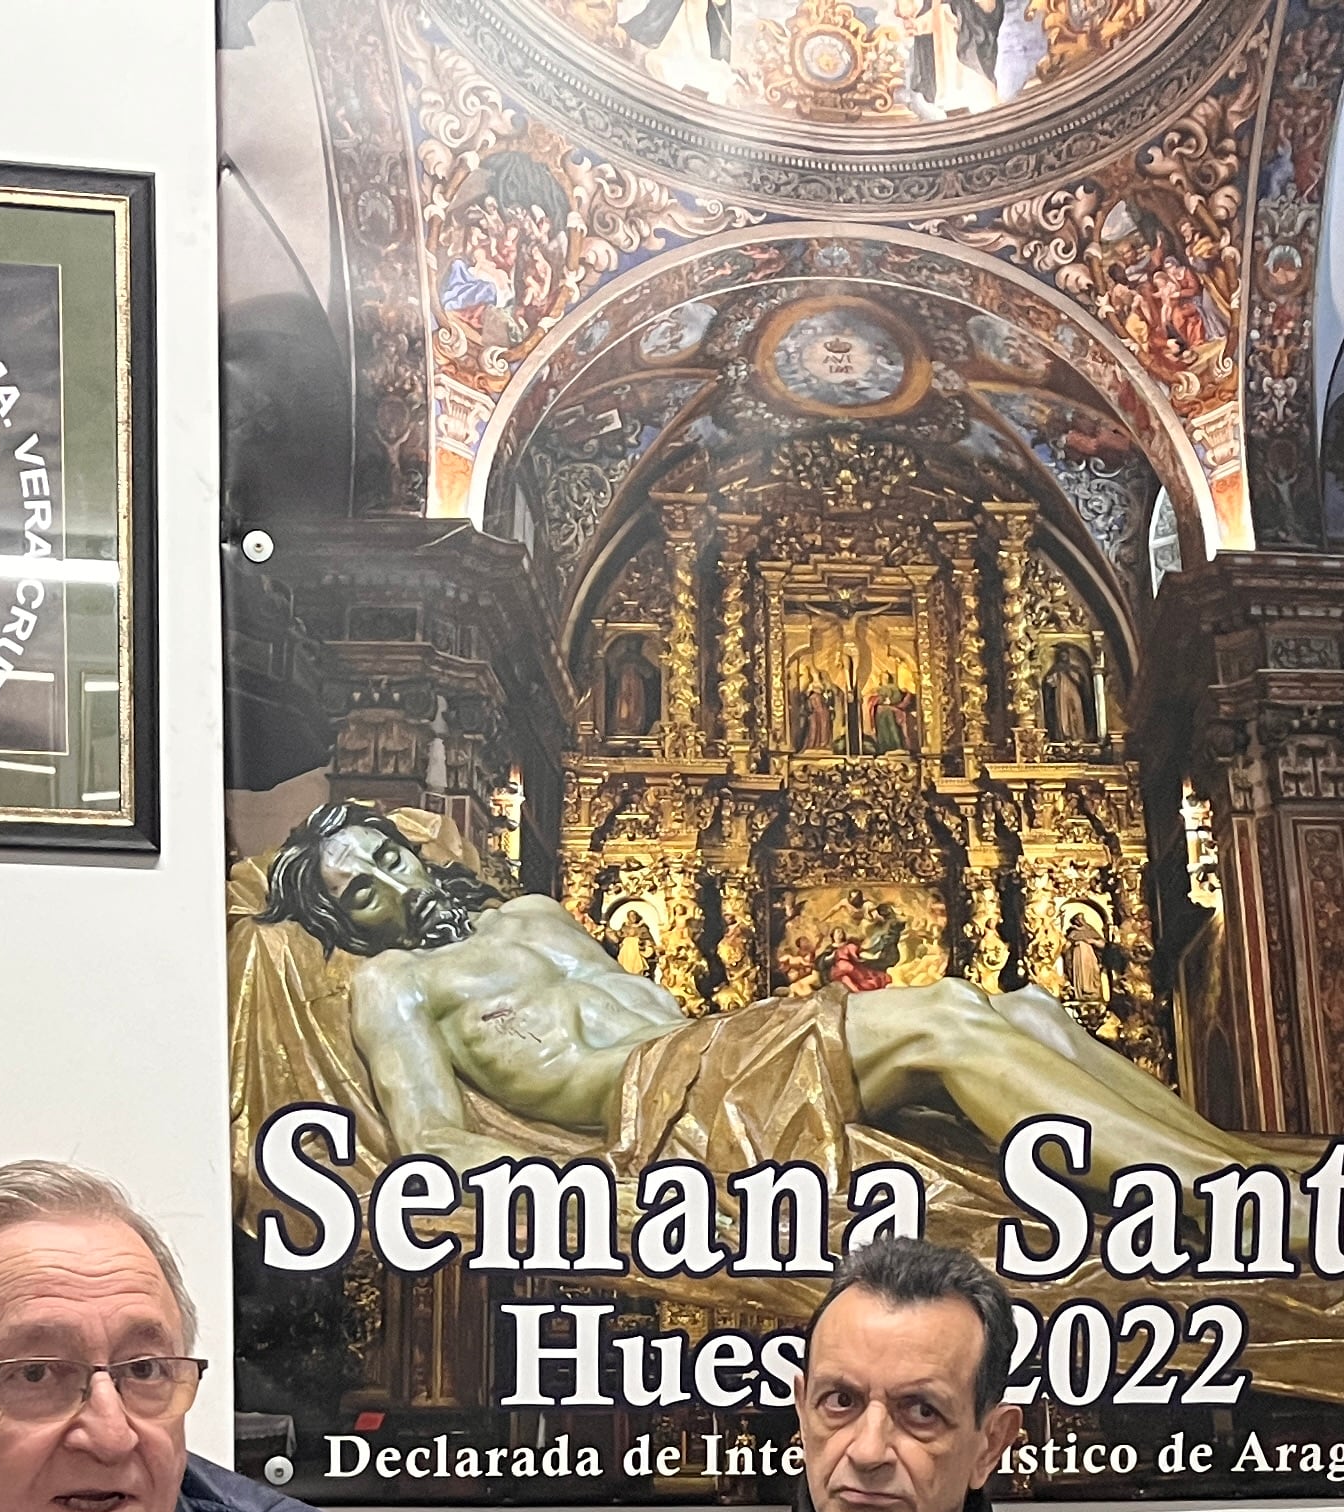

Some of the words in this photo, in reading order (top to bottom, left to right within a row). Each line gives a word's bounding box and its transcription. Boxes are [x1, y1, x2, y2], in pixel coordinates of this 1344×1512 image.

[259, 1105, 924, 1273] Semana
[501, 1303, 807, 1408] Hues
[1004, 1304, 1253, 1406] 2022
[324, 1434, 604, 1479] Declarada
[623, 1435, 680, 1478] de
[701, 1434, 806, 1478] Inte
[1158, 1432, 1213, 1474] de
